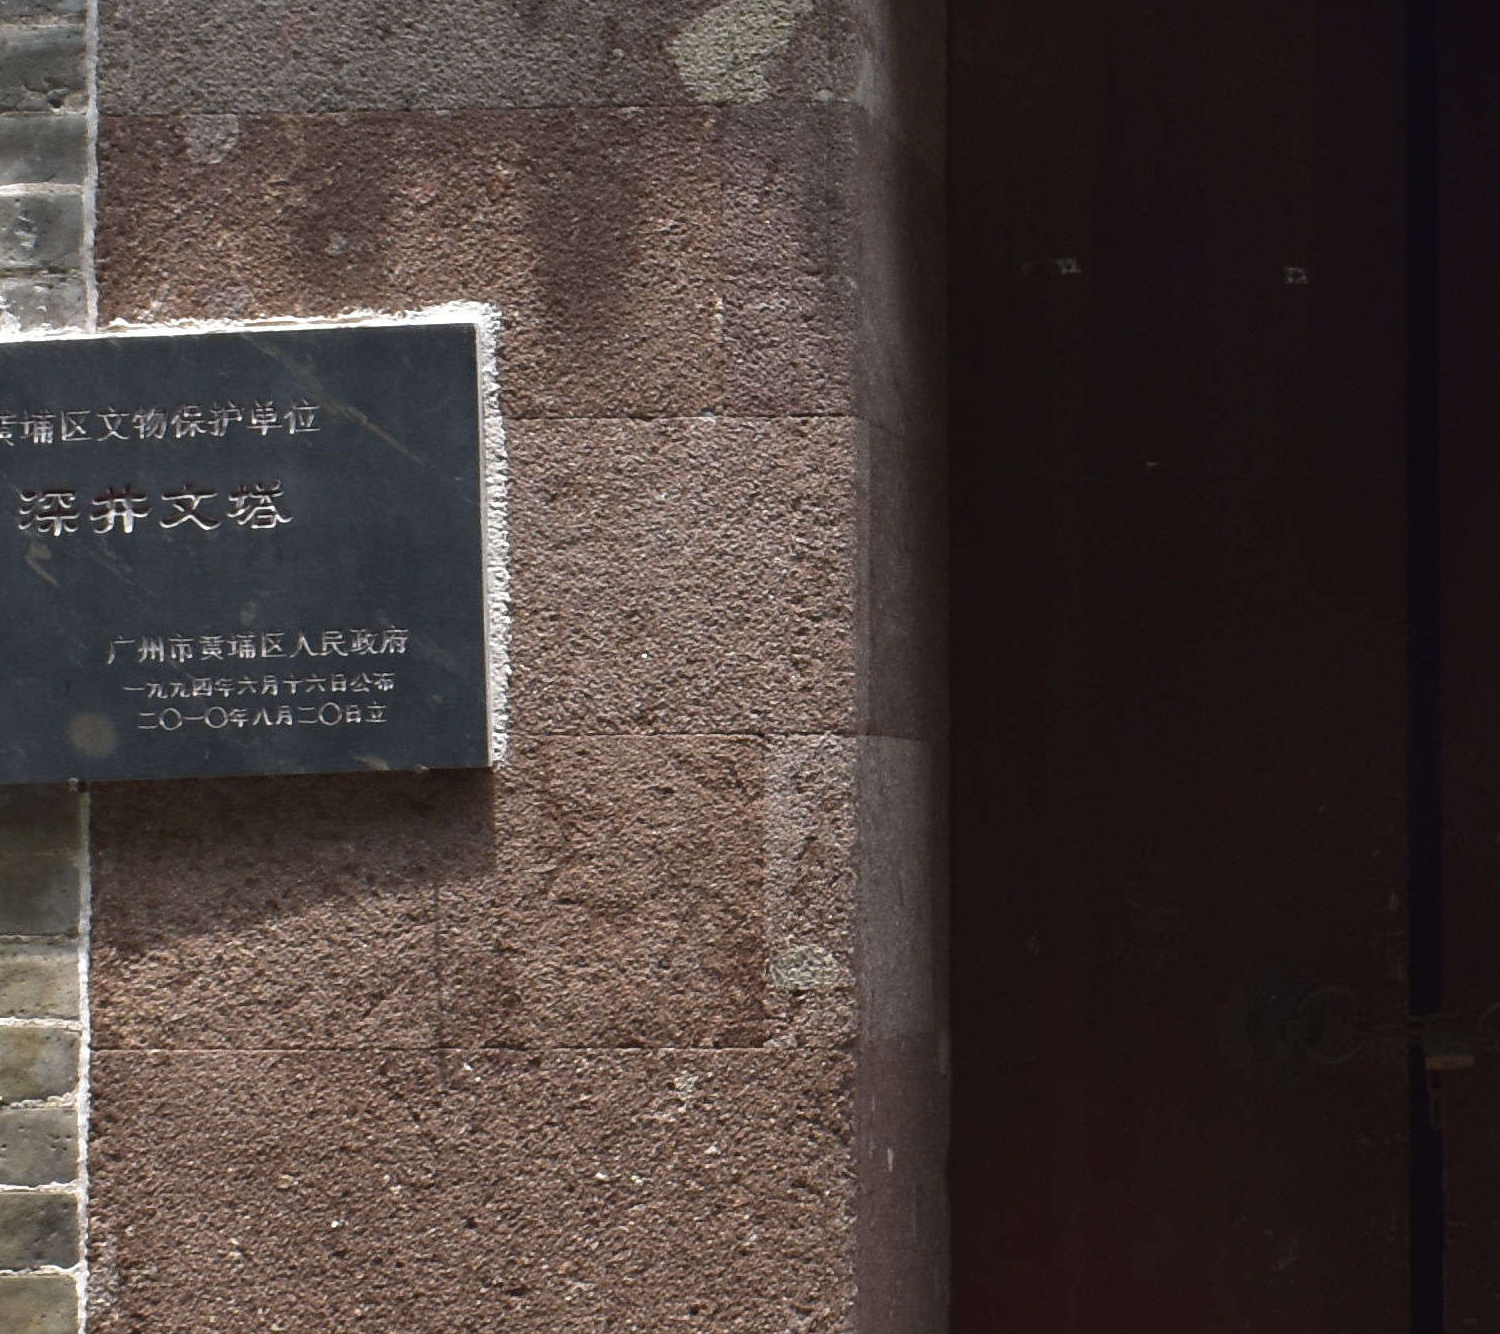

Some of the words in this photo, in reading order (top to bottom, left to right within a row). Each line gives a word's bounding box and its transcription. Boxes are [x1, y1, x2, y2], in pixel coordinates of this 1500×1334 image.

[17, 482, 293, 537] 深井文塔
[107, 625, 410, 665] 广州市黄埔区人民政府
[123, 672, 396, 699] 一九九四年六月十六日公布
